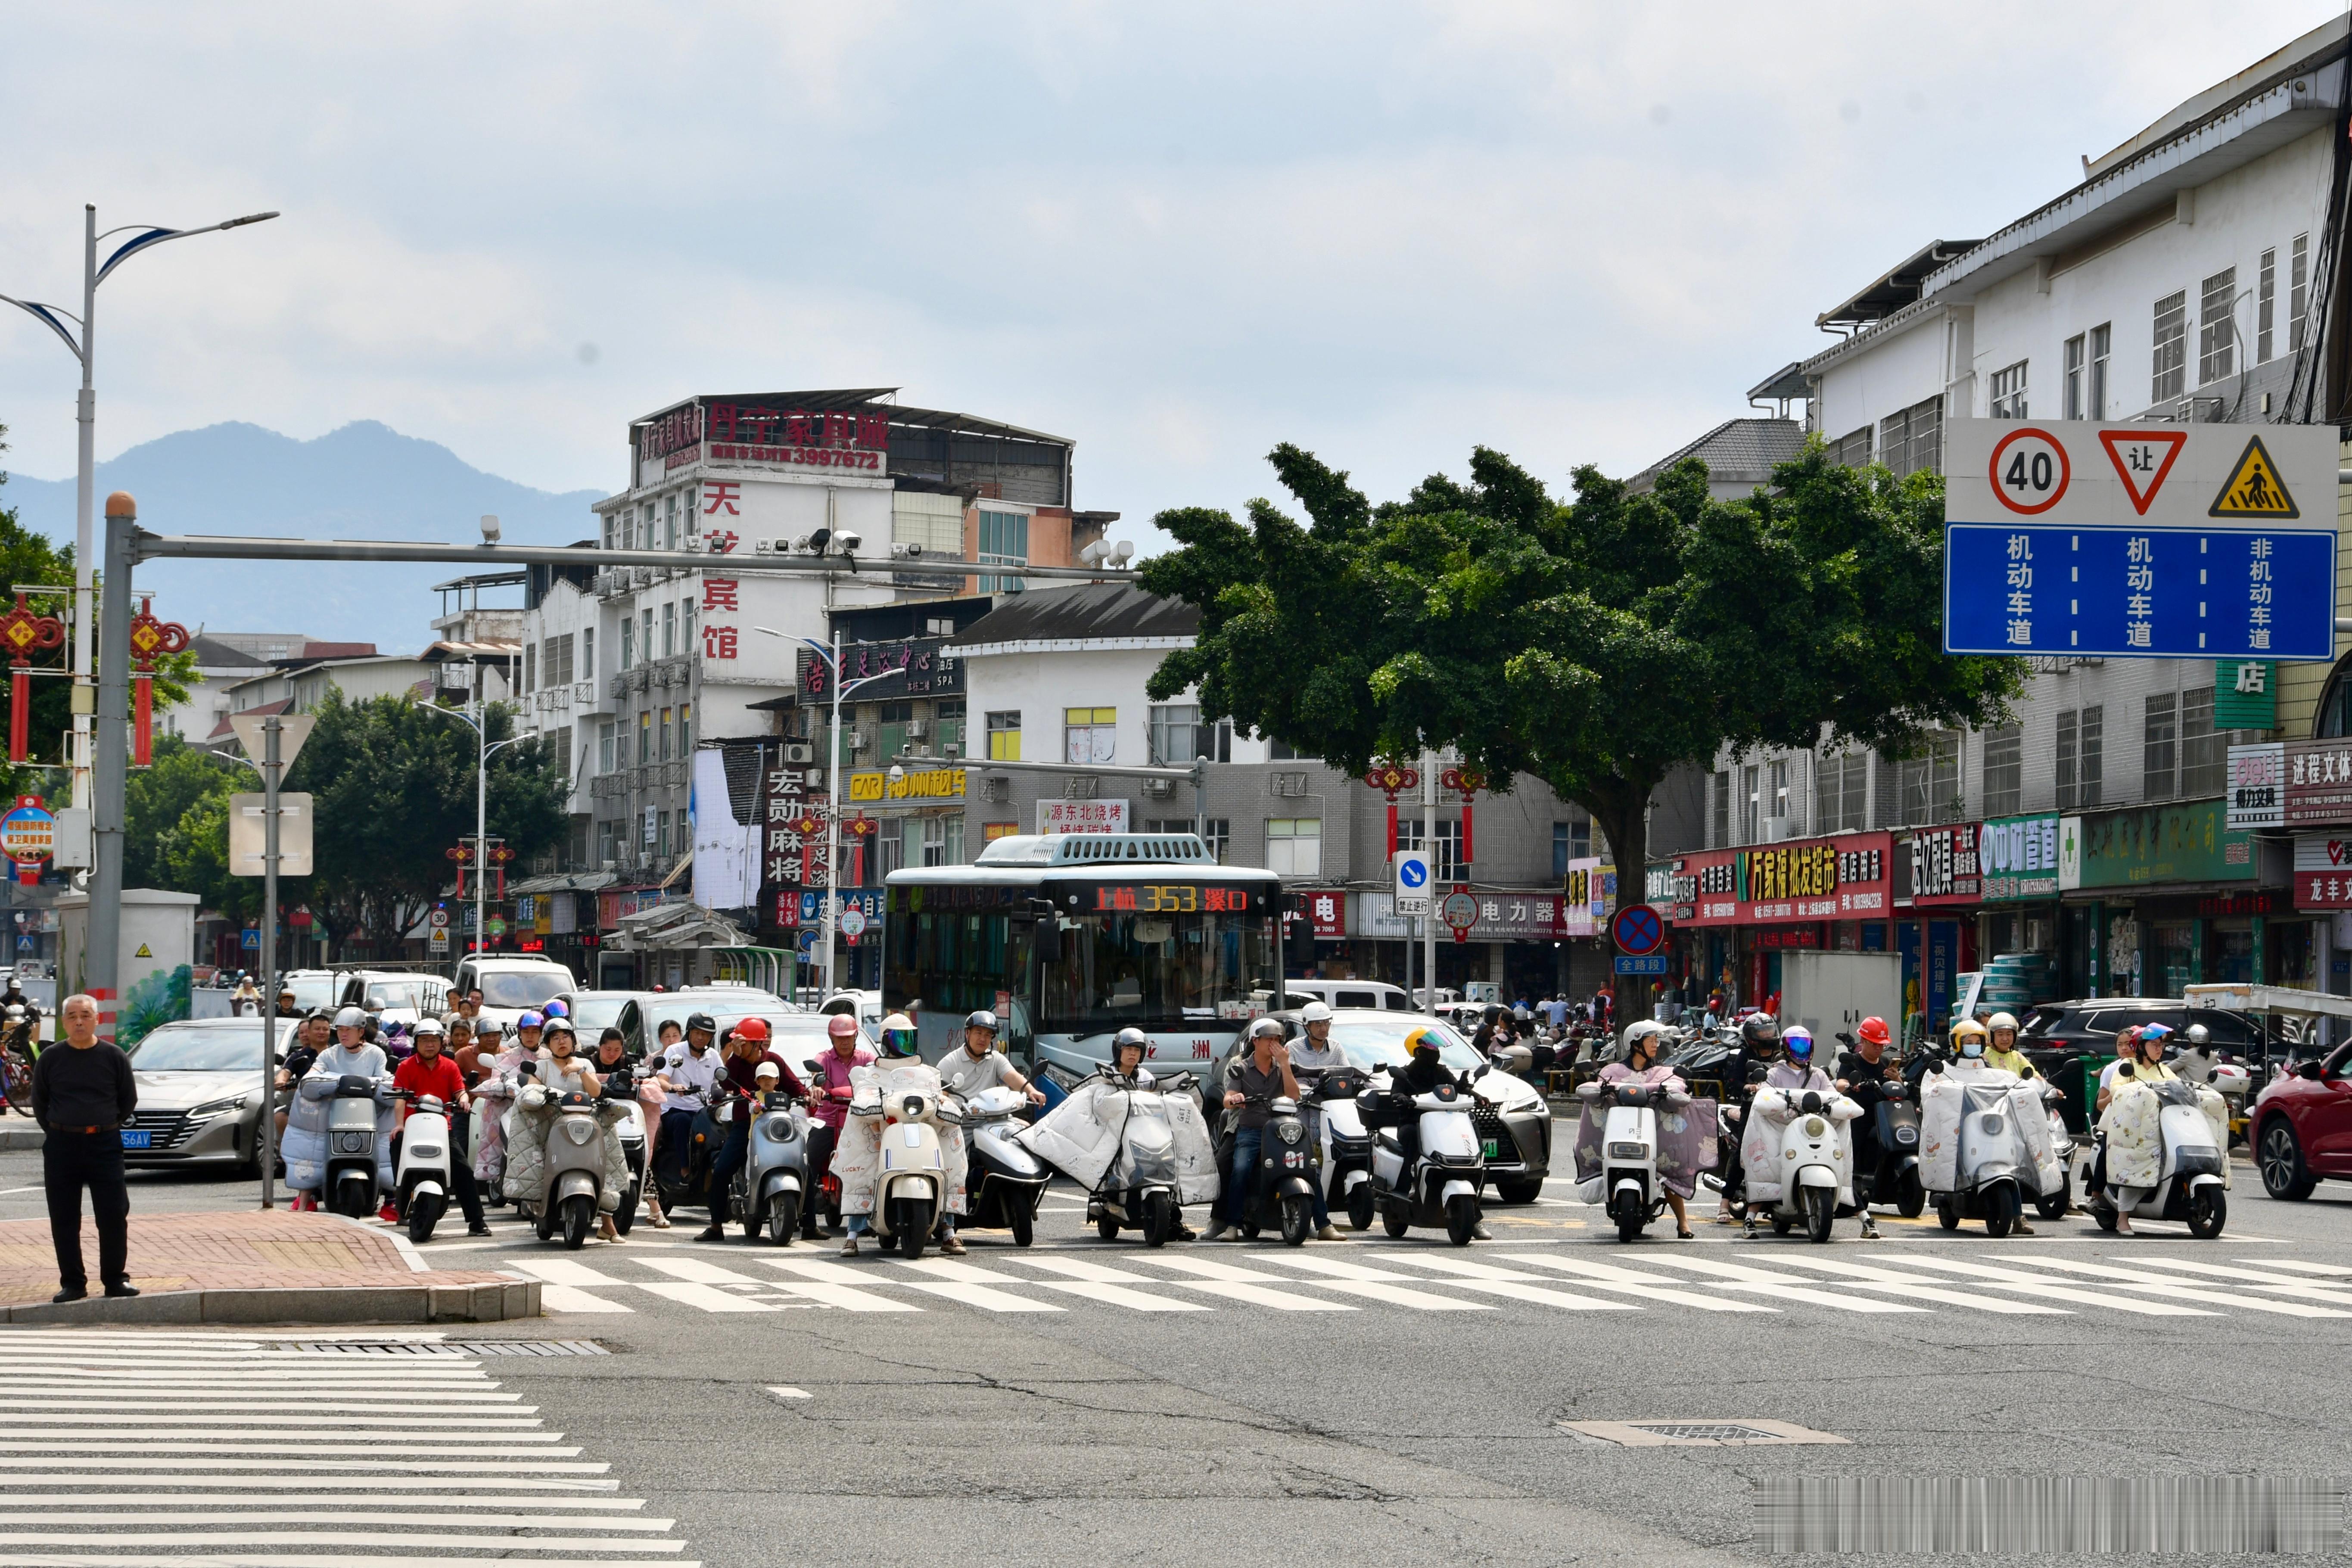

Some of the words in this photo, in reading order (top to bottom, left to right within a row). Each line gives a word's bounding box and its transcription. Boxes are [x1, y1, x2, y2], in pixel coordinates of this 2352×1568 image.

[709, 402, 889, 450] 丹宁家具城
[2006, 451, 2053, 491] 40
[2128, 445, 2153, 472] 让
[2006, 534, 2033, 646] 机动车道
[2127, 537, 2153, 647] 机动车道
[2249, 538, 2273, 650] 非机动车道
[937, 676, 953, 686] SPA
[2235, 662, 2265, 693] 店
[2235, 753, 2276, 786] deli
[2293, 750, 2351, 785] 进程文体
[852, 777, 879, 796] CAR
[2236, 788, 2274, 808] 得力文具
[768, 769, 804, 882] 宏勋麻将
[1051, 804, 1121, 821] 源东北烧烤
[1701, 864, 1732, 894] 日用百货
[1753, 845, 1835, 901] 万家福批发超市
[1839, 849, 1879, 883] 酒店用品
[1912, 830, 1952, 897] 宏亿厨具
[1092, 887, 1137, 910] 上杭
[1143, 886, 1197, 912] 353
[1205, 888, 1248, 912] 溪口
[1399, 900, 1428, 912] 禁止逆行
[1621, 959, 1660, 971] 全路段
[1934, 945, 1945, 993] 视贝插座
[1177, 1107, 1185, 1122] GET
[121, 1133, 149, 1145] 56AV
[1484, 1142, 1495, 1154] 41
